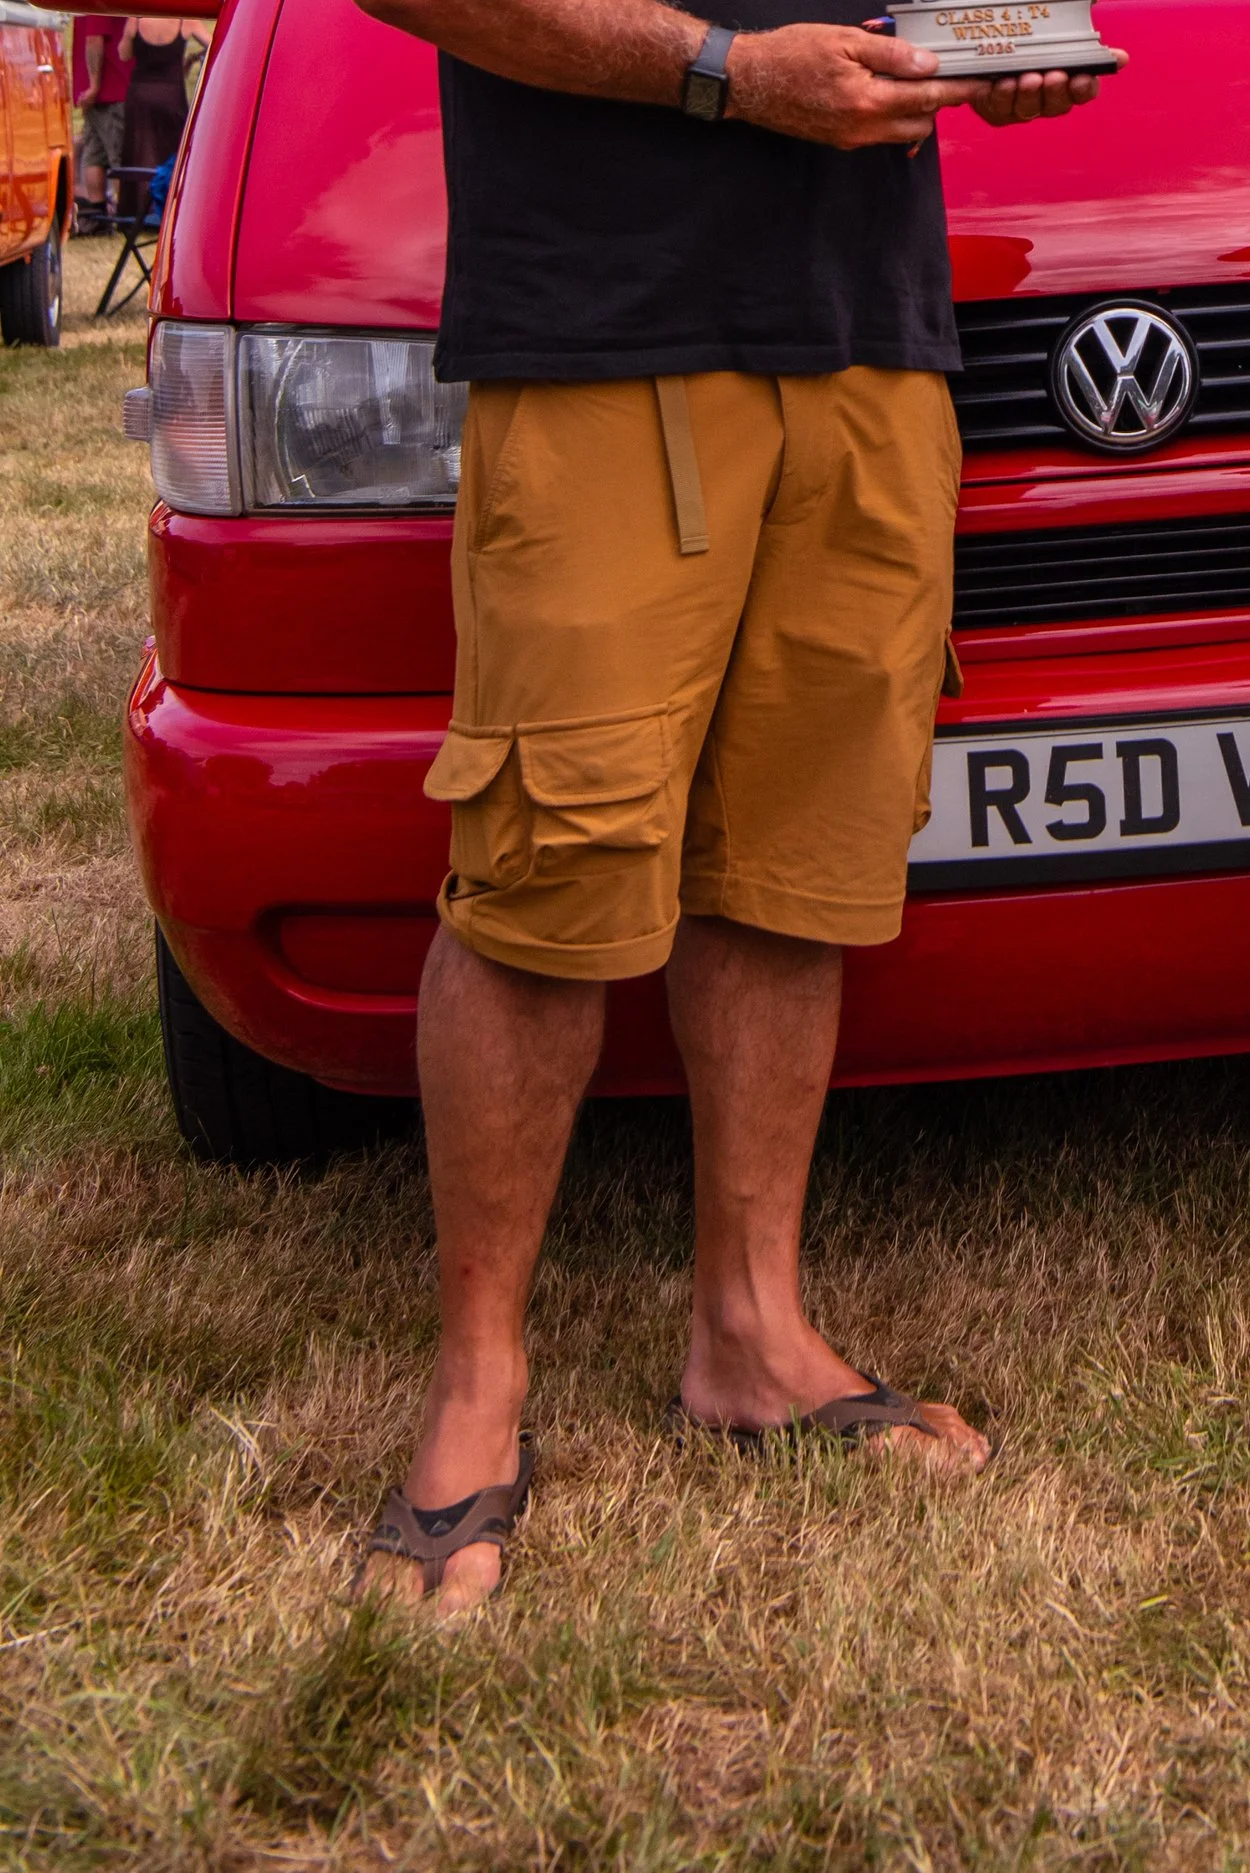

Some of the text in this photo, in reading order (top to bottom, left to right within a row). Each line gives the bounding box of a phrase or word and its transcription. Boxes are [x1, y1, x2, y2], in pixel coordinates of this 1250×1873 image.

[935, 9, 994, 26] CLASS
[1001, 8, 1011, 21] 4
[1027, 5, 1050, 19] T4
[953, 22, 1033, 40] WINNER
[966, 736, 1181, 848] R5D
